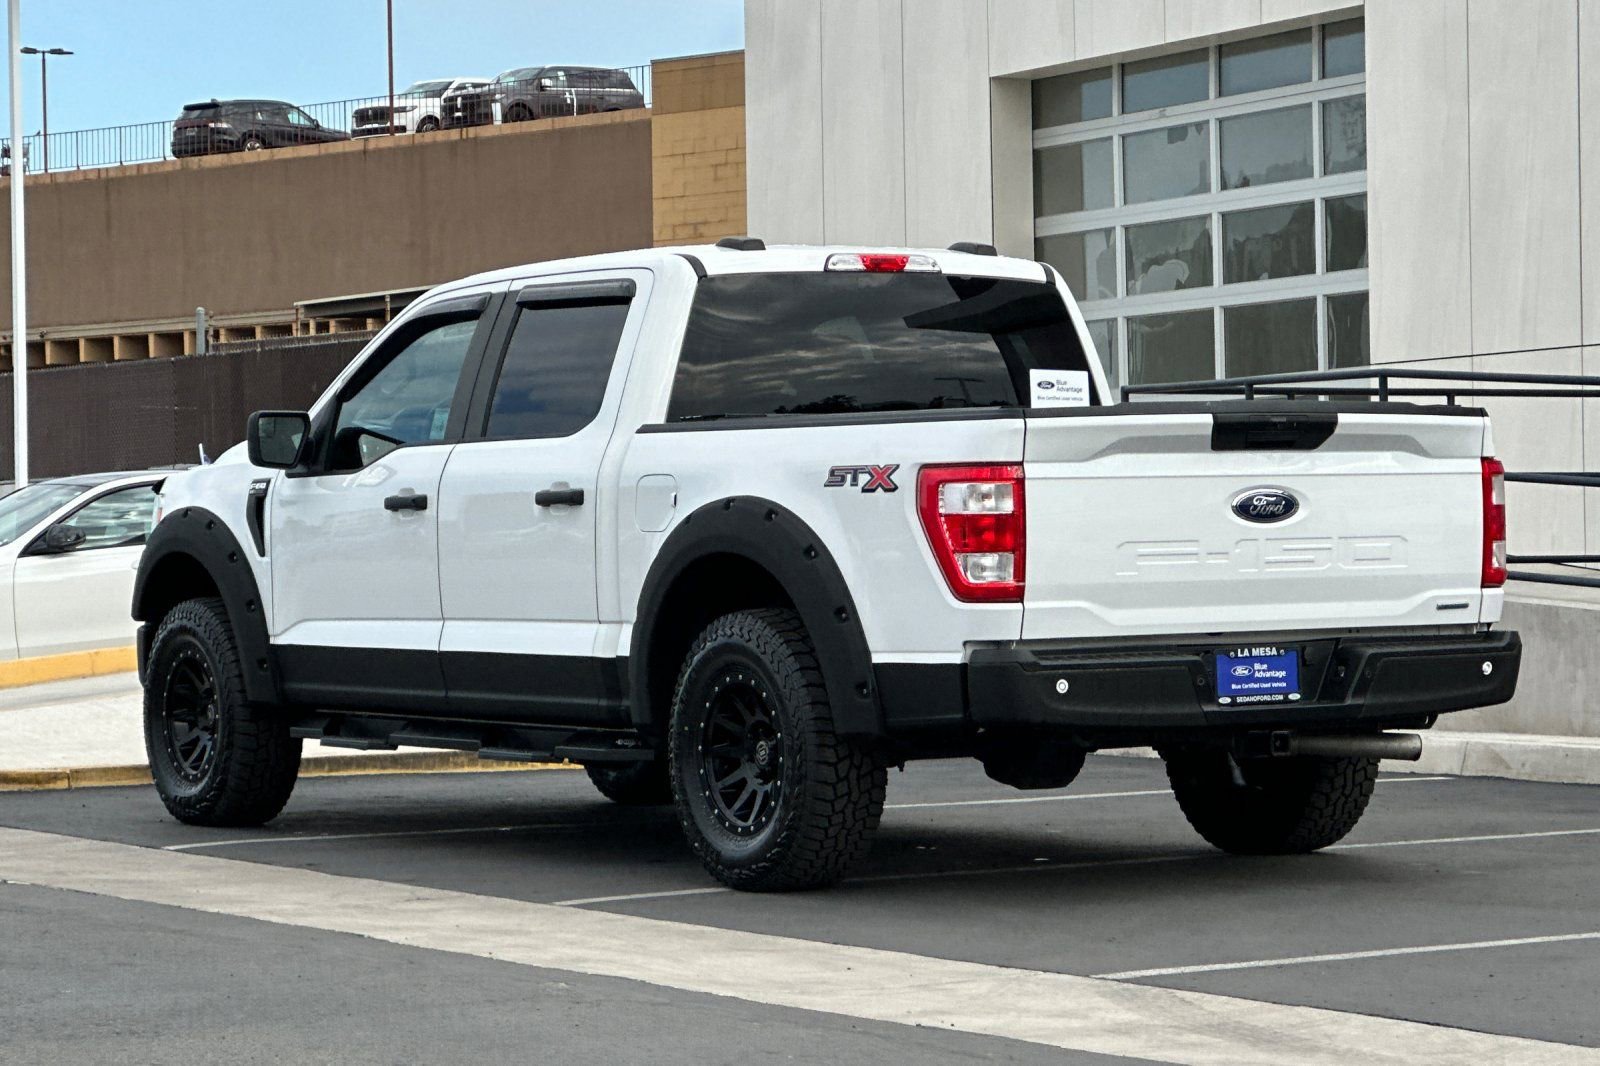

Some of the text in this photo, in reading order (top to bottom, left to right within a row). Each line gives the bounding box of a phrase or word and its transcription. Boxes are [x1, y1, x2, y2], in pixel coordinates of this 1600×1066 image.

[824, 464, 901, 493] STX
[1116, 535, 1408, 576] F-150
[1237, 647, 1278, 657] LA MESA
[1254, 670, 1287, 678] Advantage
